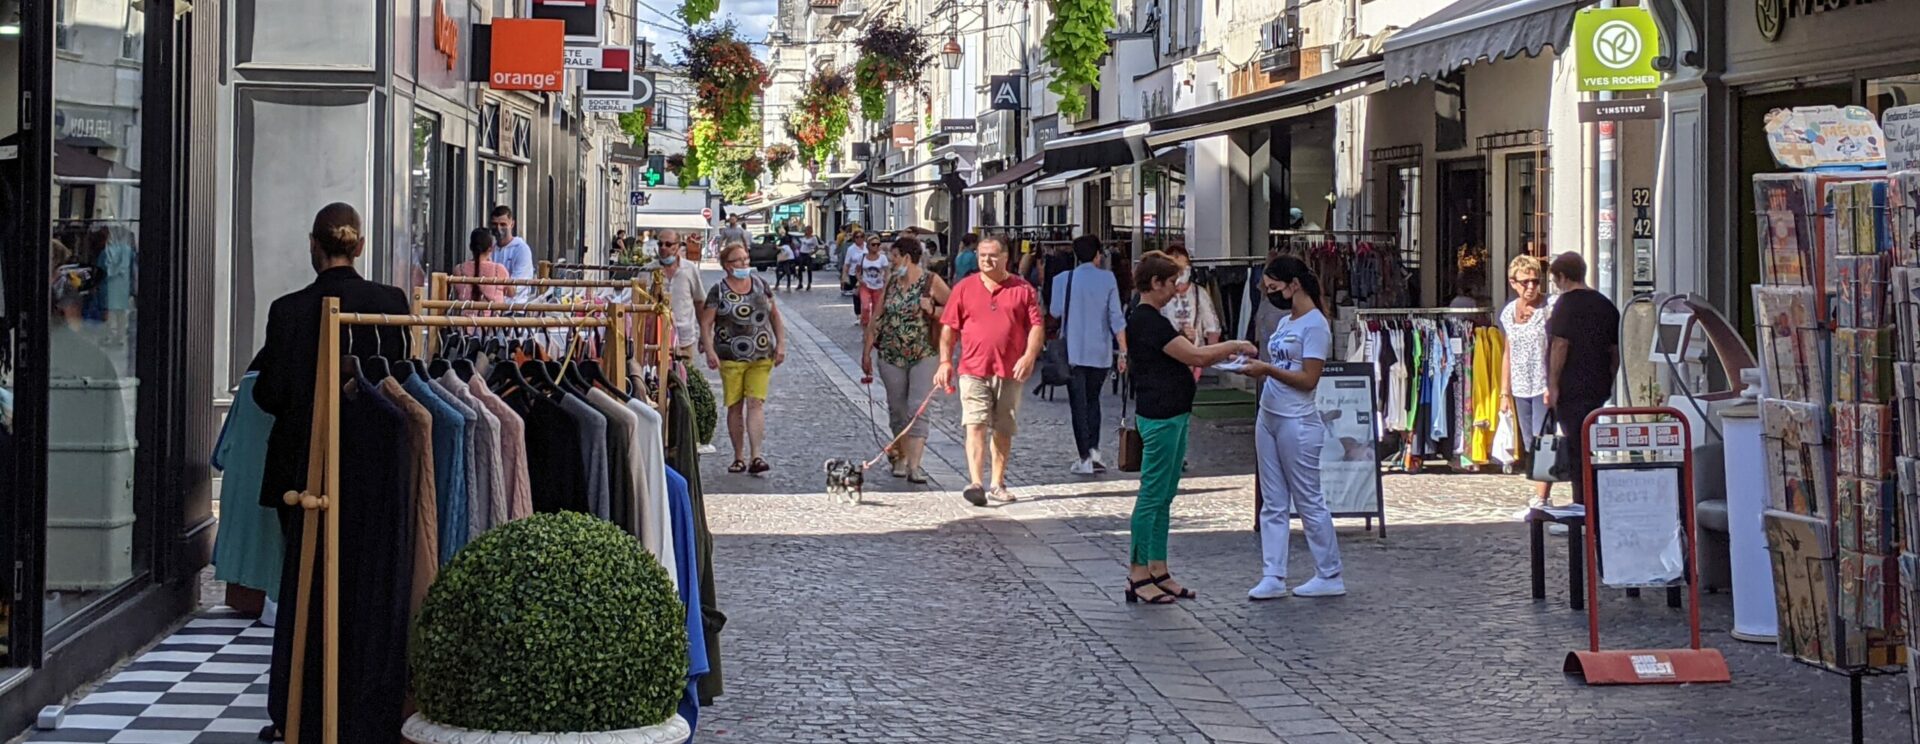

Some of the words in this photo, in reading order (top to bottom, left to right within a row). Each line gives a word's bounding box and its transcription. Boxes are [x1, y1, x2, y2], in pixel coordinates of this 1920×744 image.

[494, 72, 556, 89] orange
[1583, 77, 1609, 86] YVES
[1612, 75, 1656, 85] ROCHER
[1596, 105, 1646, 115] L'INSTITUT
[1822, 122, 1873, 137] MÉGA
[1633, 189, 1650, 206] 32
[1634, 218, 1651, 236] 42
[1597, 428, 1611, 436] SUD
[1627, 427, 1641, 435] SUD
[1657, 426, 1671, 434] SUD
[1597, 436, 1618, 445] OUEST
[1627, 435, 1648, 445] OUEST
[1657, 434, 1679, 444] OUEST
